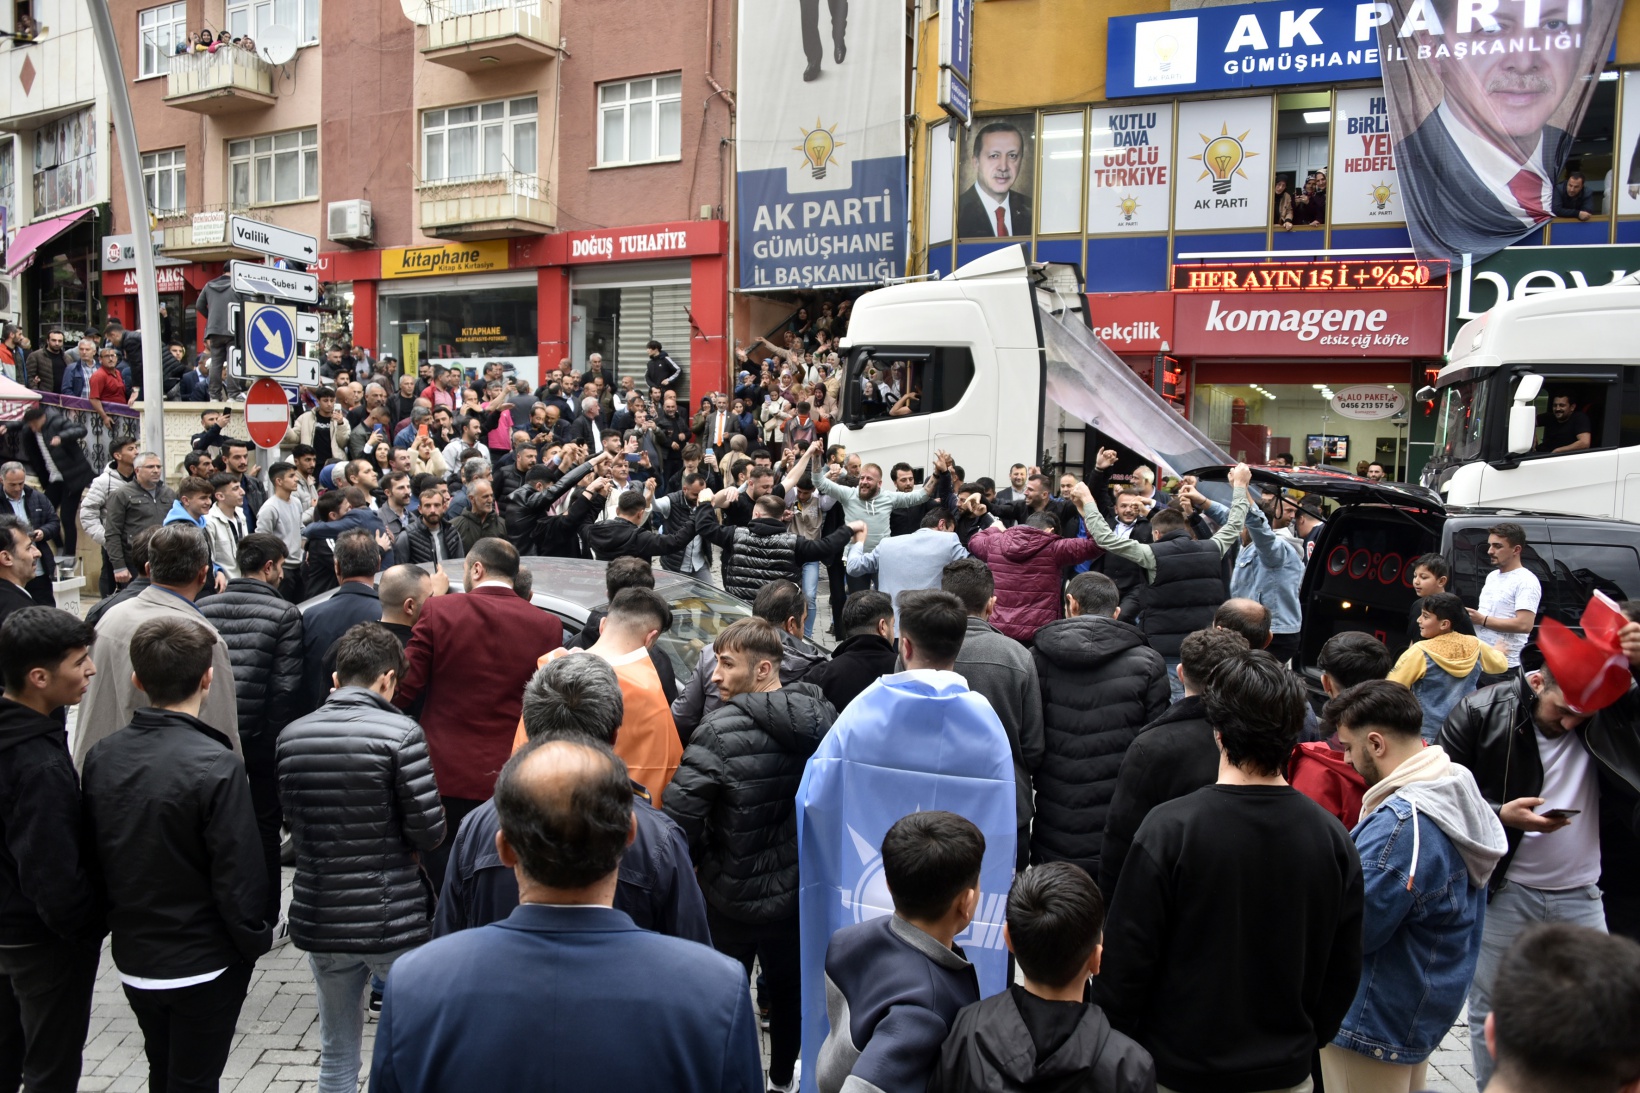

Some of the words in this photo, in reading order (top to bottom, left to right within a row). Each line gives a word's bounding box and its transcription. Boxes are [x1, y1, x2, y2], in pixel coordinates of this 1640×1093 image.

[1224, 7, 1324, 53] AK
[1224, 48, 1378, 75] GÜMÜŞHANE
[1387, 44, 1408, 62] İL
[1417, 31, 1581, 60] BAŞKANLIĞI
[1109, 112, 1157, 130] KUTLU
[1347, 115, 1390, 135] BİRLİ
[1113, 130, 1149, 147] DAVA
[1344, 156, 1396, 173] HEDEFL
[1094, 166, 1167, 187] TÜRKİYE
[753, 203, 796, 231] AK
[803, 188, 892, 228] PARTİ
[1194, 199, 1211, 210] AK
[1215, 197, 1248, 209] PARTİ
[236, 226, 270, 245] Valilik
[572, 234, 613, 259] DOĞUŞ
[619, 227, 687, 254] TUHAFİYE
[753, 231, 894, 260] GÜMÜŞHANE
[402, 249, 480, 272] kitaphane
[754, 265, 771, 286] İL
[775, 257, 896, 287] BAŞKANLIĞI
[1188, 271, 1239, 289] HER
[1244, 269, 1304, 288] AYIN
[1308, 269, 1333, 287] 15
[1205, 299, 1388, 342] komagene
[1320, 334, 1349, 346] etsiz
[1351, 333, 1372, 349] çiğ
[1373, 333, 1410, 348] köfte
[1347, 393, 1362, 401] ALO
[1364, 393, 1389, 401] PAKET
